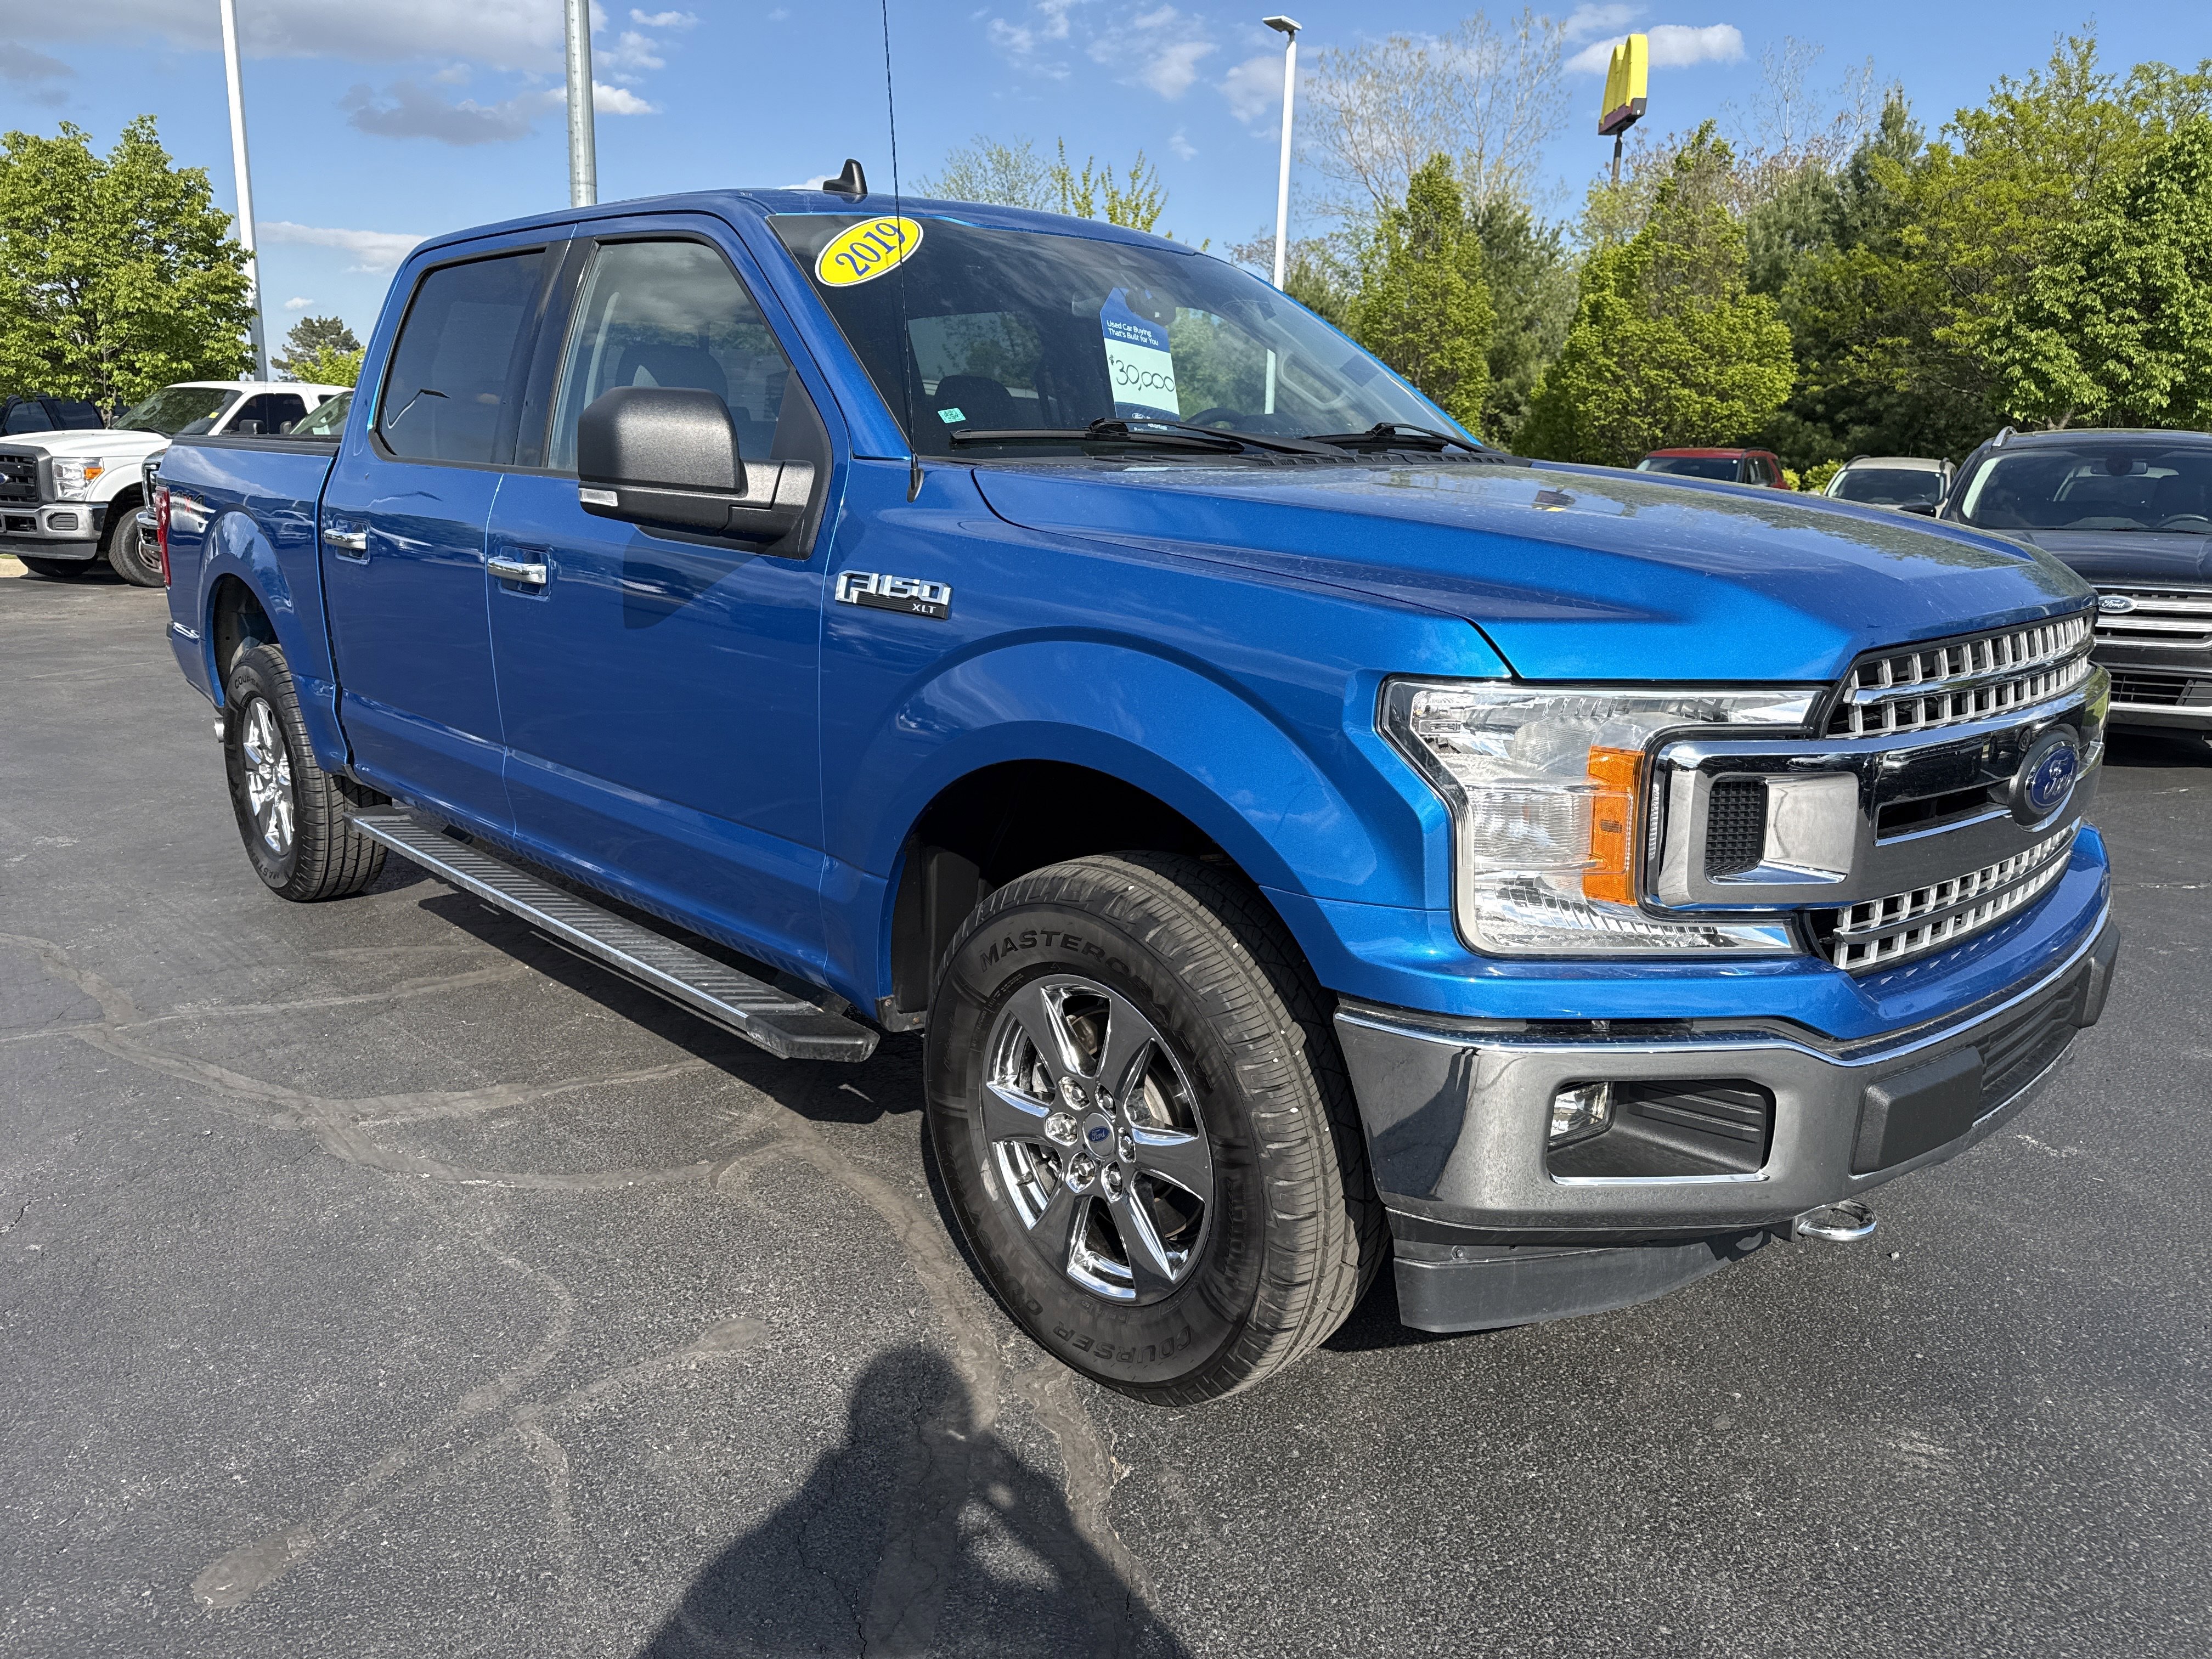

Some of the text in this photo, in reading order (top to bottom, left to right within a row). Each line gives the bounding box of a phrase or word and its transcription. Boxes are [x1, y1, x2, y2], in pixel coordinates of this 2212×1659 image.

[835, 223, 906, 276] 2019
[1107, 319, 1152, 338] Used Car Buying
[1107, 328, 1126, 338] That's
[1127, 332, 1139, 341] Built
[1148, 337, 1159, 346] You
[1109, 354, 1175, 392] $30,000
[911, 603, 937, 614] XLT
[2101, 599, 2126, 608] Ford
[2043, 757, 2075, 800] Ford
[980, 929, 1214, 1092] MASTERCRAFT
[1091, 1128, 1107, 1141] Ford
[1053, 1321, 1192, 1363] COURSER
